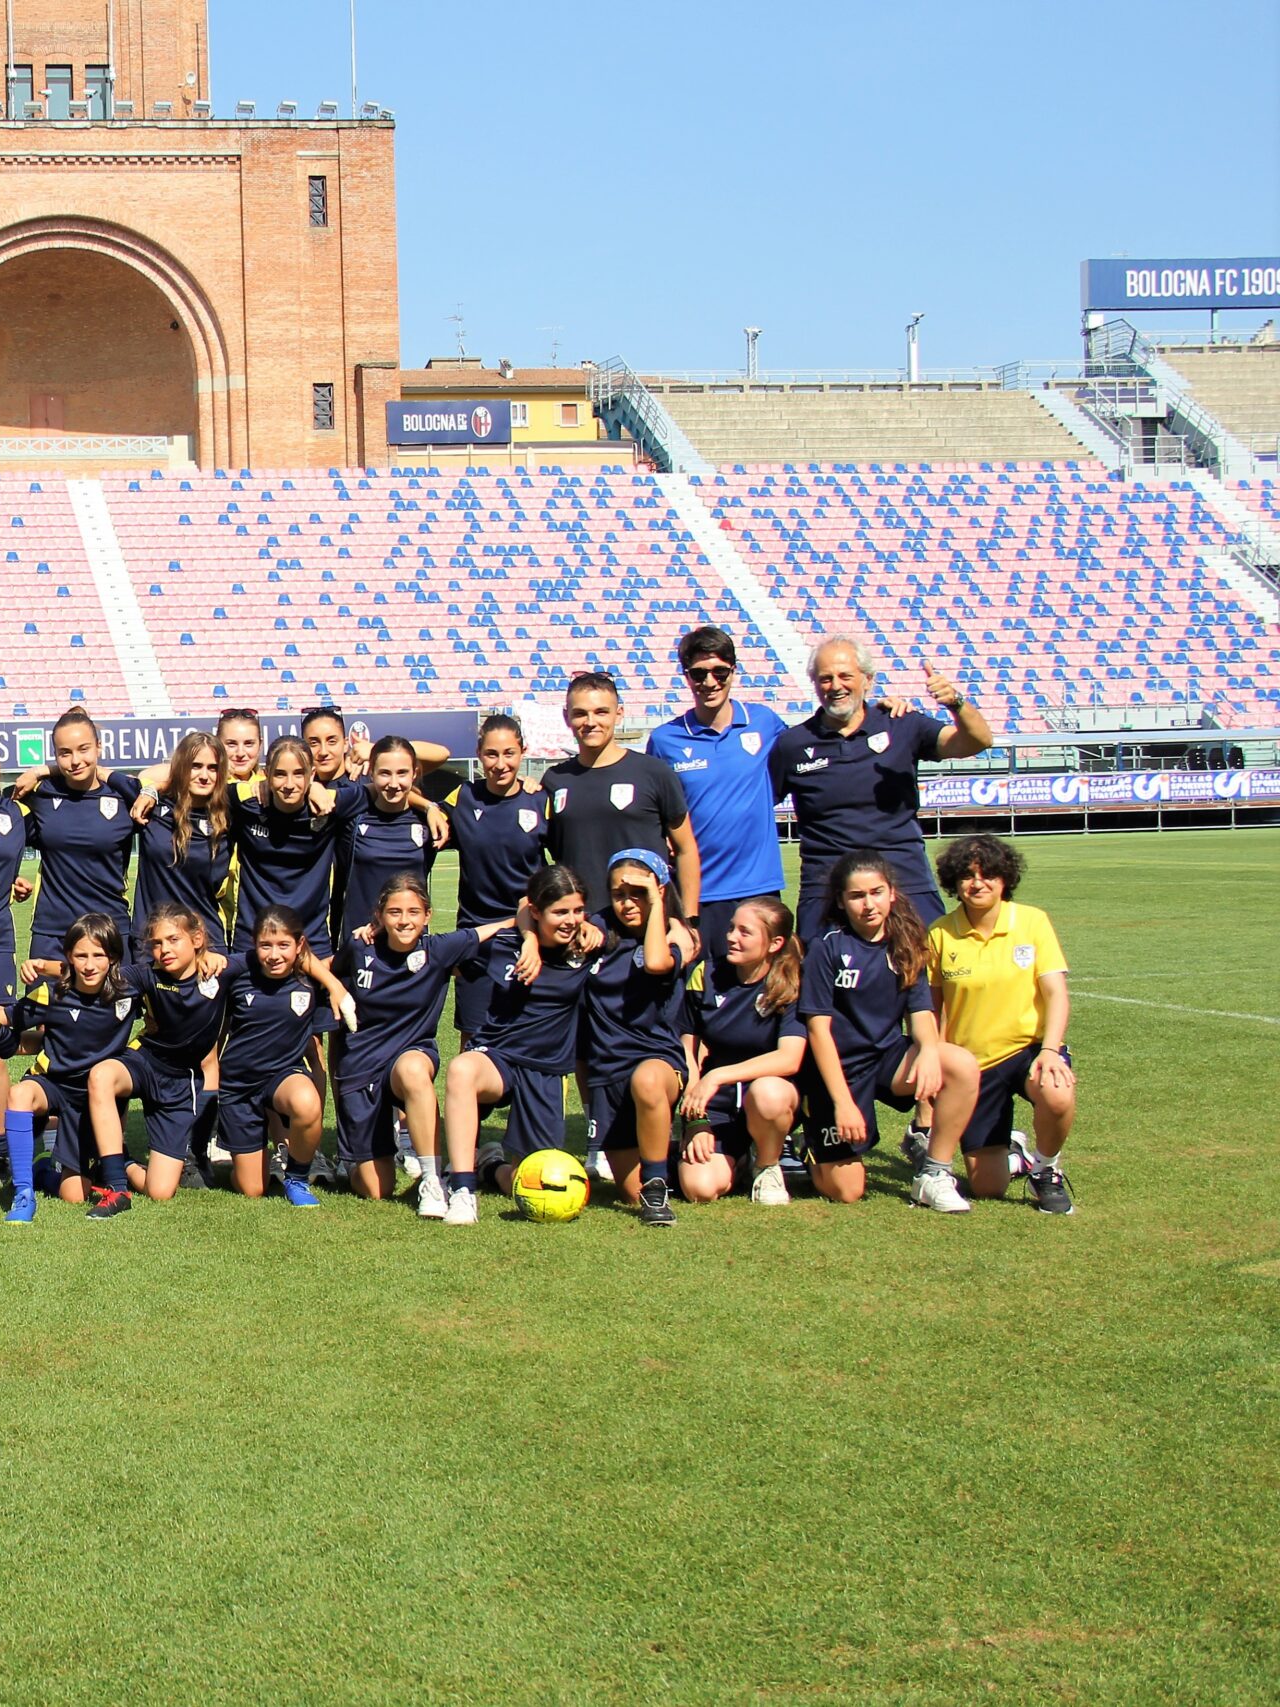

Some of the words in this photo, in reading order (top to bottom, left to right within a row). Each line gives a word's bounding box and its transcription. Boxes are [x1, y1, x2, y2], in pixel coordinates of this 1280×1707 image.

[1126, 269, 1210, 297] BOLOGNA
[1215, 269, 1238, 297] FC
[403, 414, 457, 431] BOLOGNA
[99, 727, 196, 759] RENAT
[357, 968, 373, 989] 211
[835, 969, 860, 988] 267
[821, 1126, 847, 1146] 26
